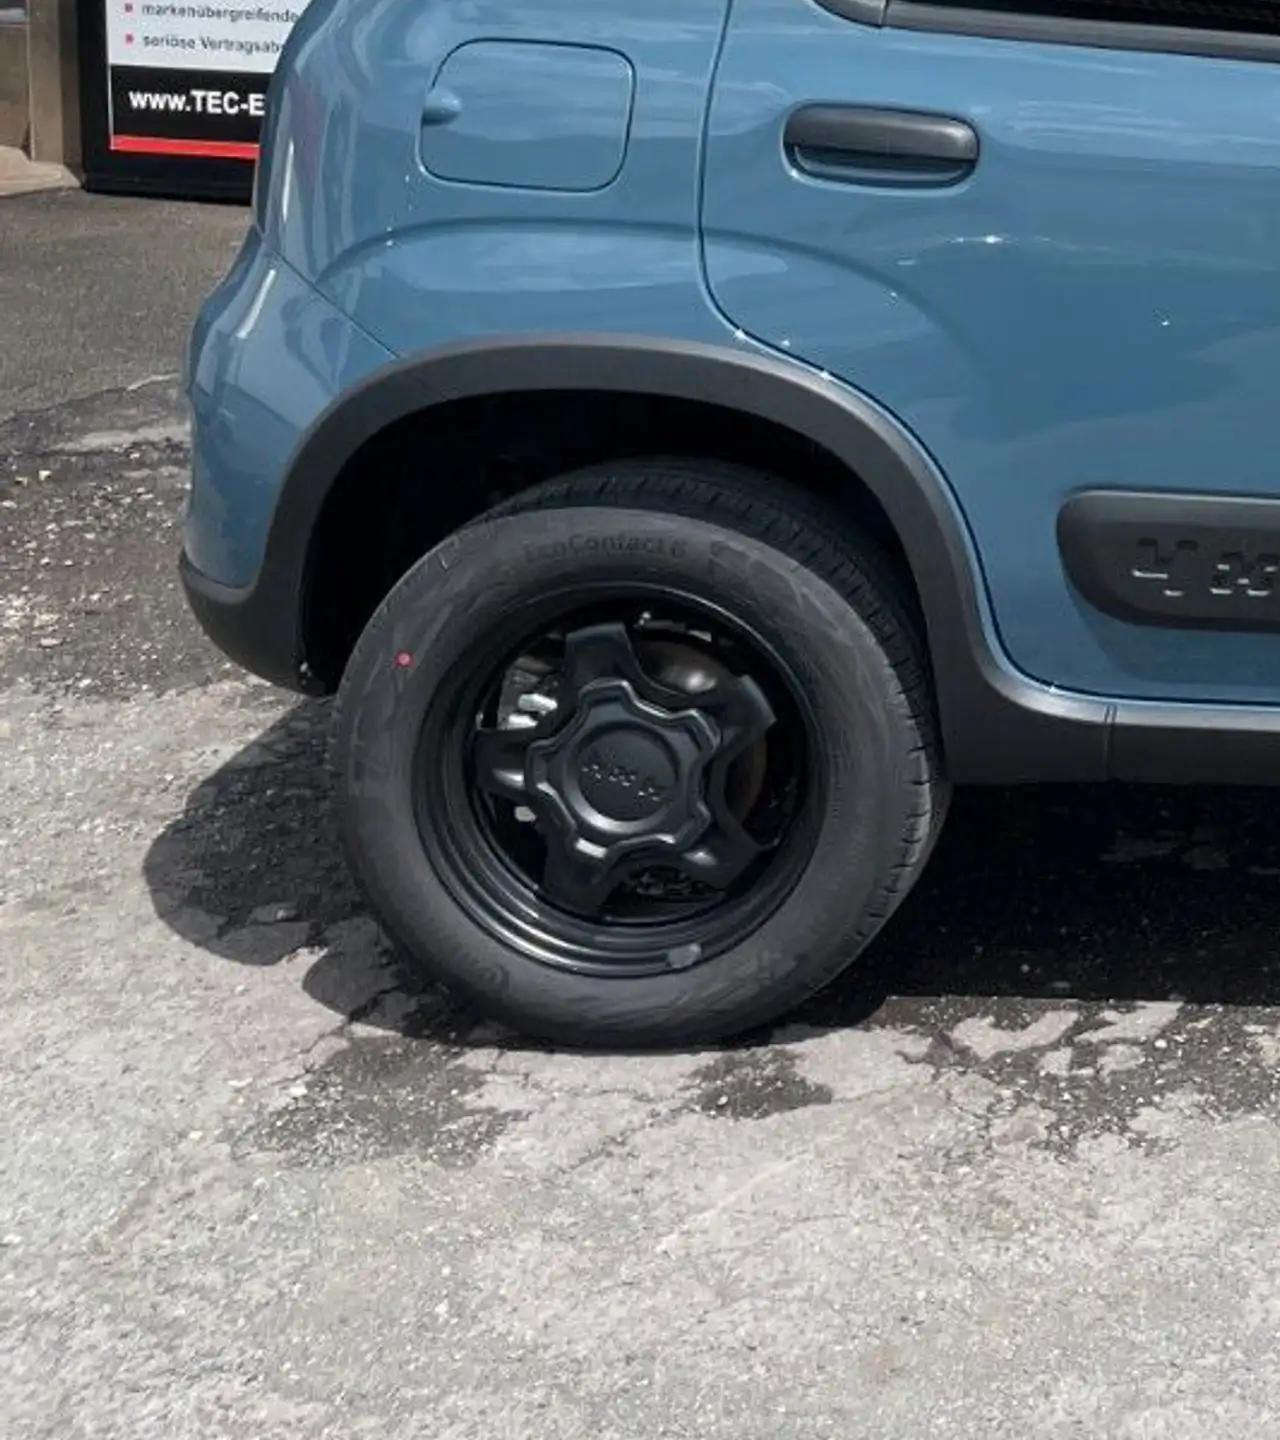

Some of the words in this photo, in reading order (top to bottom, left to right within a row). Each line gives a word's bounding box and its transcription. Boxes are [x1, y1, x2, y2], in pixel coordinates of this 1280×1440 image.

[143, 34, 196, 50] seriöse
[200, 36, 285, 55] Vertragsab
[128, 88, 266, 117] www.TEC-E
